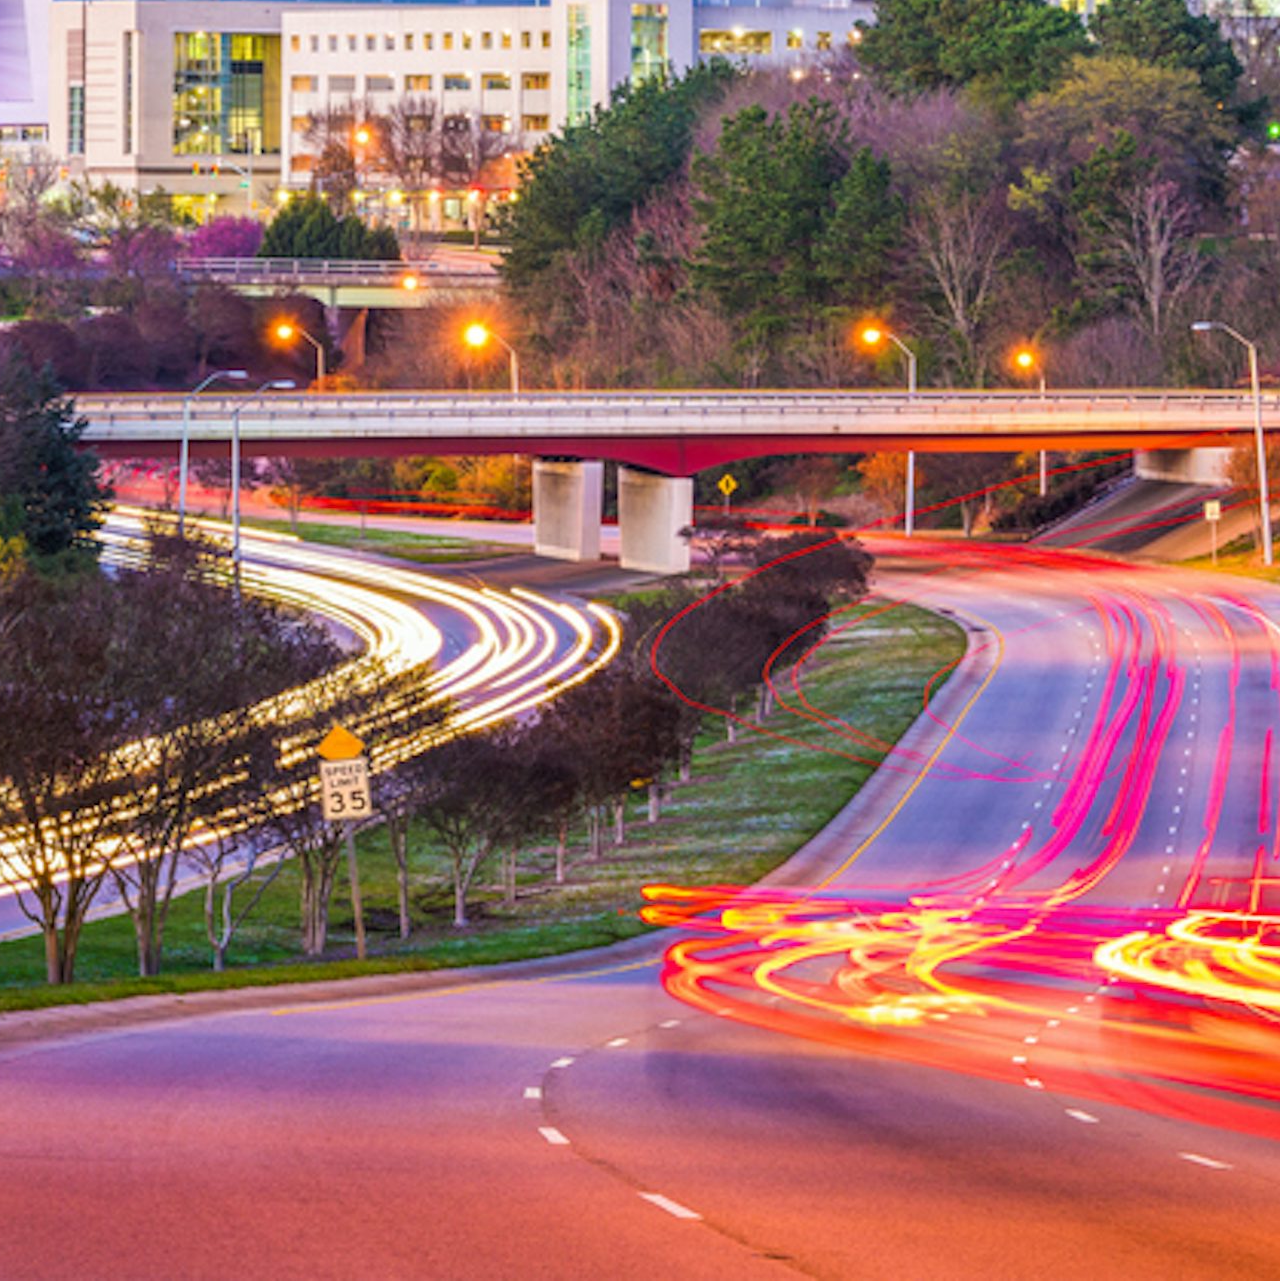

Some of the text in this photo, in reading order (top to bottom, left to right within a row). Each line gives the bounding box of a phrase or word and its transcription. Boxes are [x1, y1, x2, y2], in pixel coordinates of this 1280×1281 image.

[325, 764, 363, 776] SPEED
[330, 777, 359, 788] LIMIT
[330, 790, 366, 814] 35
